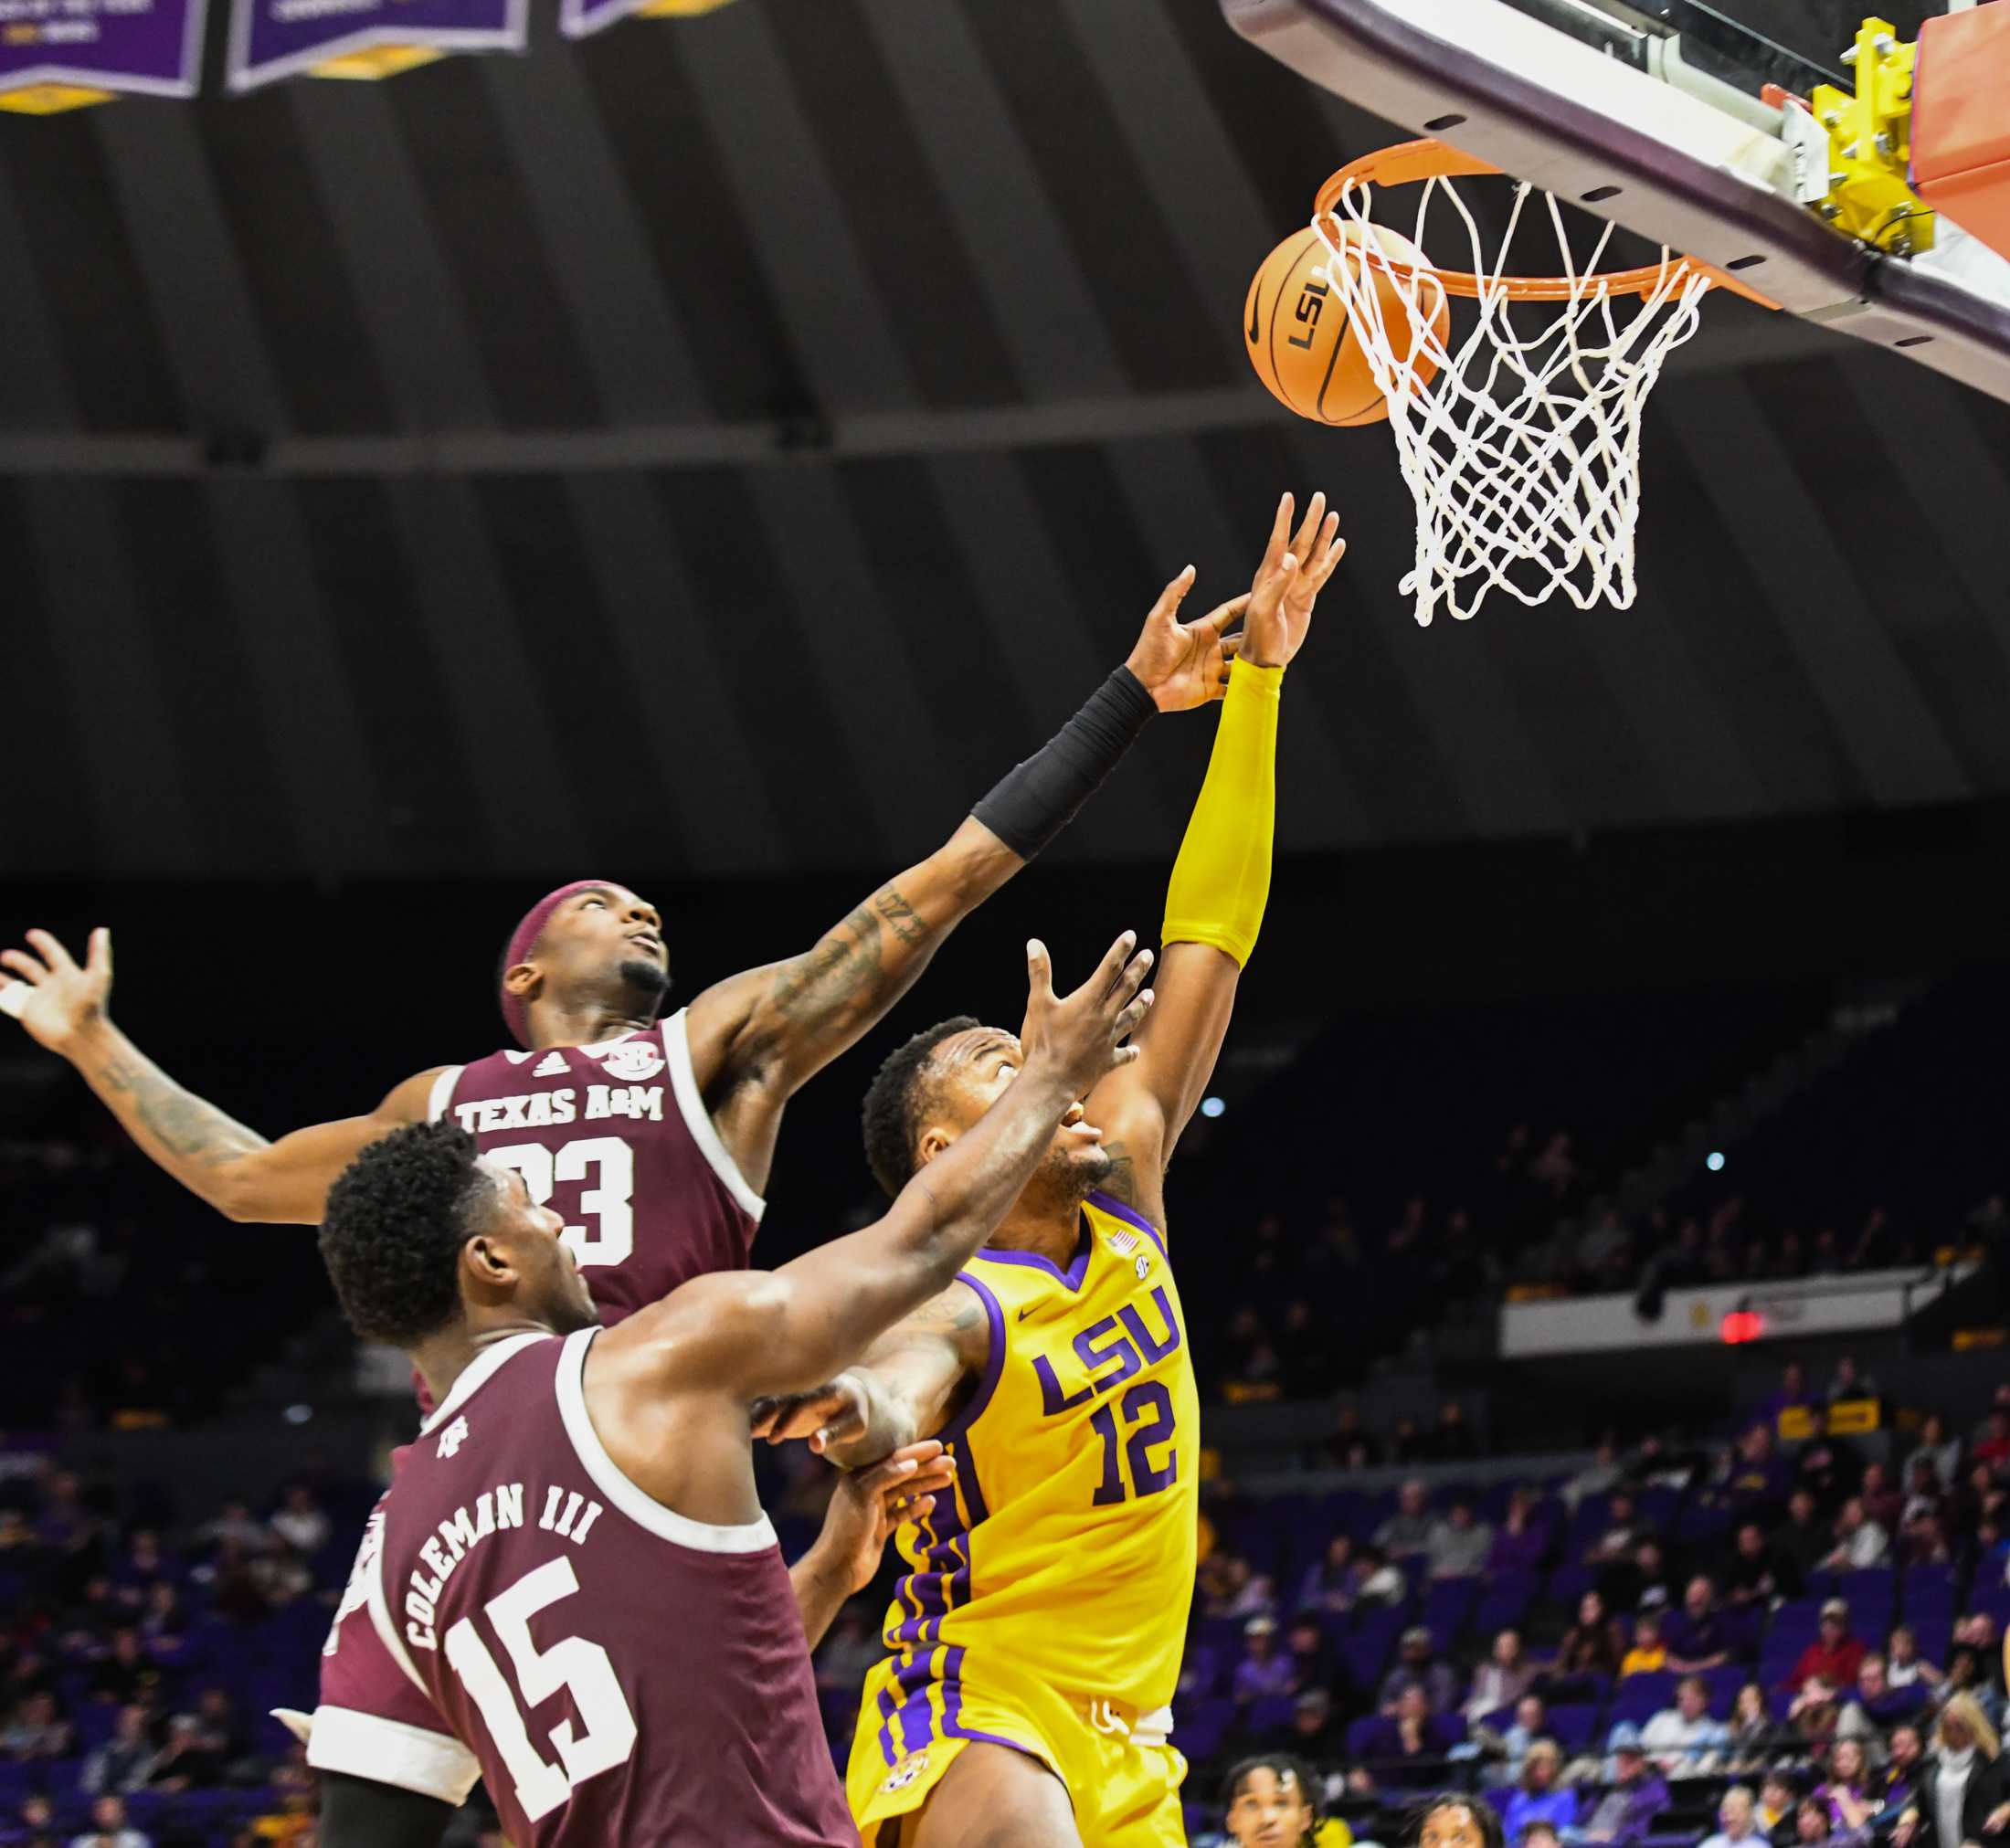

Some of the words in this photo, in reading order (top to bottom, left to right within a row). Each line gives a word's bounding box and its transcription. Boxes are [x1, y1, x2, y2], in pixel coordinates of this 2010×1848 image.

[454, 1088, 576, 1133] TEXAS
[585, 1084, 664, 1121] A&M
[1031, 1285, 1180, 1417] LSU
[1090, 1380, 1177, 1506] 12
[406, 1483, 524, 1651] COLEMAN
[538, 1484, 604, 1546] III
[444, 1555, 639, 1823] 15
